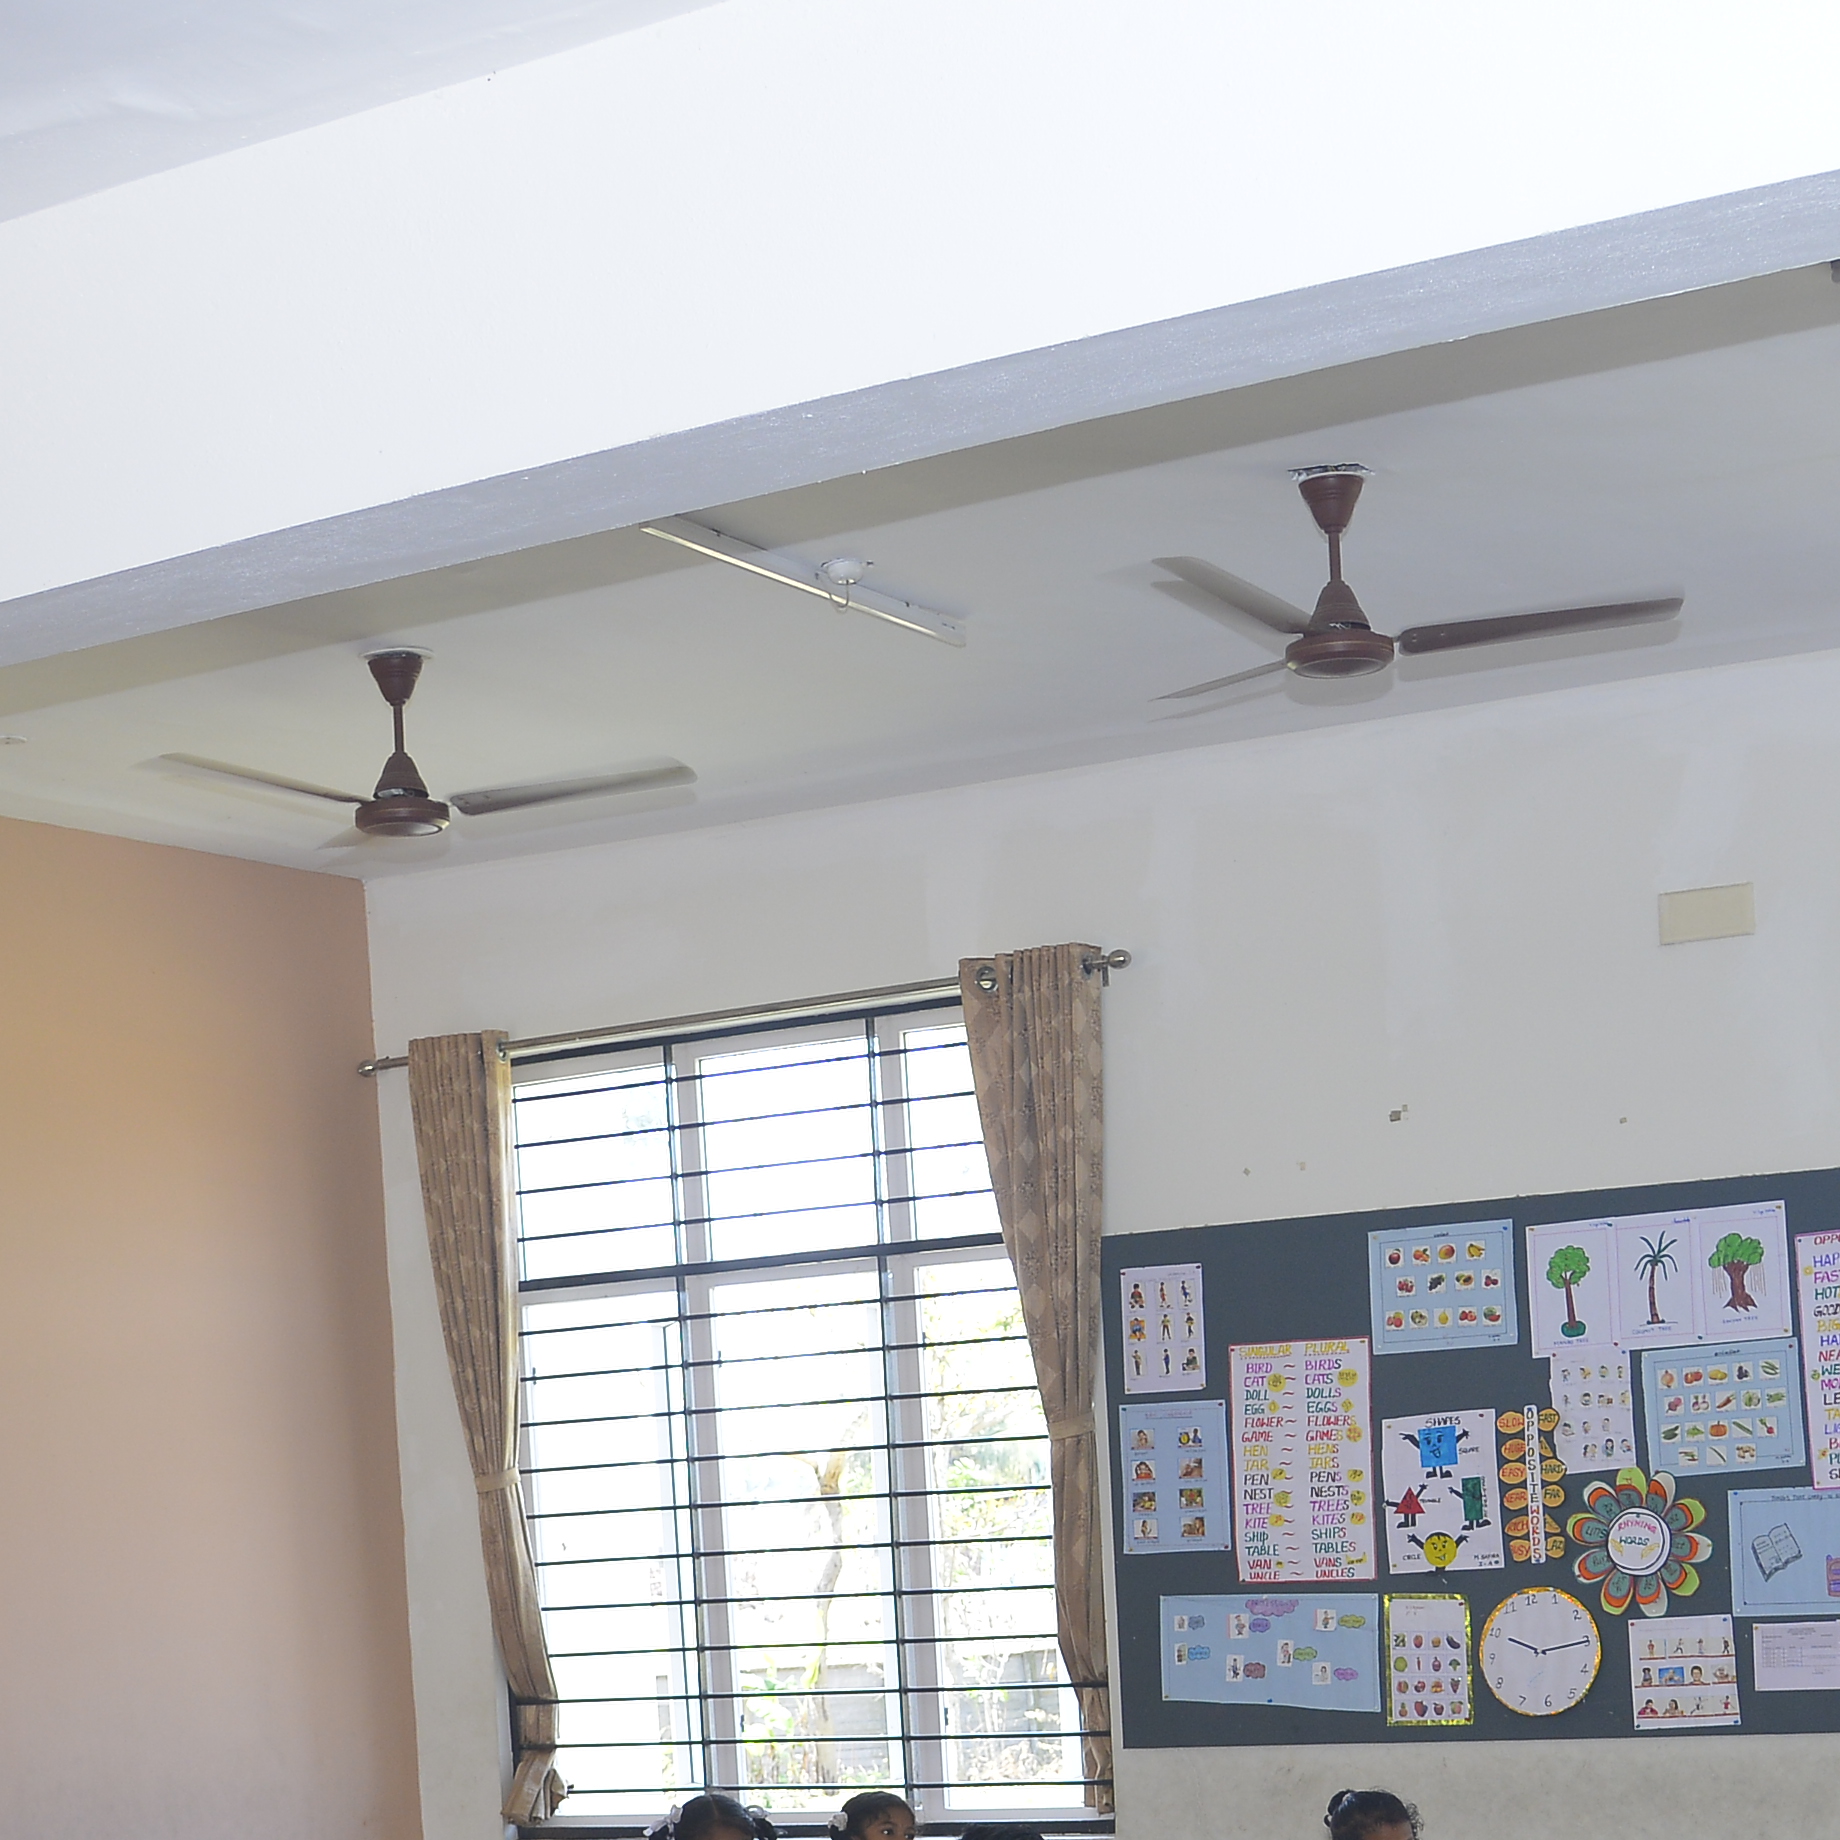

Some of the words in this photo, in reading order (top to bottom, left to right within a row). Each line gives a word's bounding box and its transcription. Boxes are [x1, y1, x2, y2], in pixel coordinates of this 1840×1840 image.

[1815, 1286, 1840, 1300] HOT
[1814, 1303, 1840, 1317] GOOD
[1817, 1319, 1840, 1332] BIG
[1239, 1344, 1292, 1357] SINGULAR
[1305, 1342, 1350, 1353] PLURAL
[1246, 1363, 1272, 1374] BIRD
[1305, 1359, 1342, 1370] BIRDS
[1244, 1376, 1266, 1387] CAT
[1305, 1374, 1334, 1385] CATS
[1245, 1390, 1269, 1400] DOLL
[1306, 1388, 1341, 1398] DOLLS
[1244, 1404, 1265, 1415] EGG
[1307, 1402, 1338, 1413] EGGS
[1244, 1417, 1283, 1428] FLOWER
[1308, 1415, 1356, 1426] FLOWERS
[1425, 1416, 1461, 1428] SHAPES
[1499, 1418, 1525, 1428] SLOW
[1539, 1413, 1558, 1424] FAST
[1242, 1431, 1274, 1442] GAME
[1306, 1429, 1344, 1442] GAMES
[1244, 1445, 1268, 1456] HEN
[1308, 1444, 1338, 1454] HENS
[1526, 1411, 1539, 1503] OPPOSITE
[1244, 1459, 1269, 1471] JAR
[1309, 1457, 1339, 1469] JARS
[1541, 1464, 1563, 1474] HARD
[1244, 1474, 1269, 1486] PEN
[1310, 1471, 1342, 1482] PENS
[1502, 1467, 1526, 1478] EASY
[1244, 1488, 1274, 1500] NEST
[1310, 1485, 1349, 1498] NESTS
[1544, 1489, 1561, 1499] FAR
[1243, 1502, 1272, 1515] TREE
[1310, 1500, 1349, 1512] TREES
[1245, 1517, 1268, 1529] KITE
[1312, 1514, 1345, 1526] KITES
[1617, 1520, 1657, 1534] RHYMING
[1312, 1527, 1346, 1540] SHIPS
[1530, 1506, 1542, 1559] WORDS
[1546, 1540, 1564, 1551] LAZ
[1620, 1536, 1650, 1546] WORDS
[1245, 1544, 1279, 1556] TABLE
[1312, 1541, 1356, 1553] TABLES
[1248, 1559, 1271, 1569] VAN
[1314, 1558, 1342, 1568] VANS
[1250, 1571, 1279, 1580] UNCLE
[1316, 1568, 1355, 1578] UNCLES
[1525, 1594, 1537, 1606] 12
[1552, 1594, 1558, 1604] 1
[1503, 1601, 1517, 1614] 11
[1572, 1610, 1582, 1620] 2
[1489, 1628, 1501, 1638] 10
[1582, 1635, 1590, 1647] 3
[1489, 1653, 1495, 1665] 9
[1580, 1663, 1589, 1674] 4
[1495, 1677, 1503, 1689] 8
[1567, 1688, 1577, 1699] 5
[1519, 1695, 1527, 1705] 7
[1544, 1695, 1552, 1707] 6
